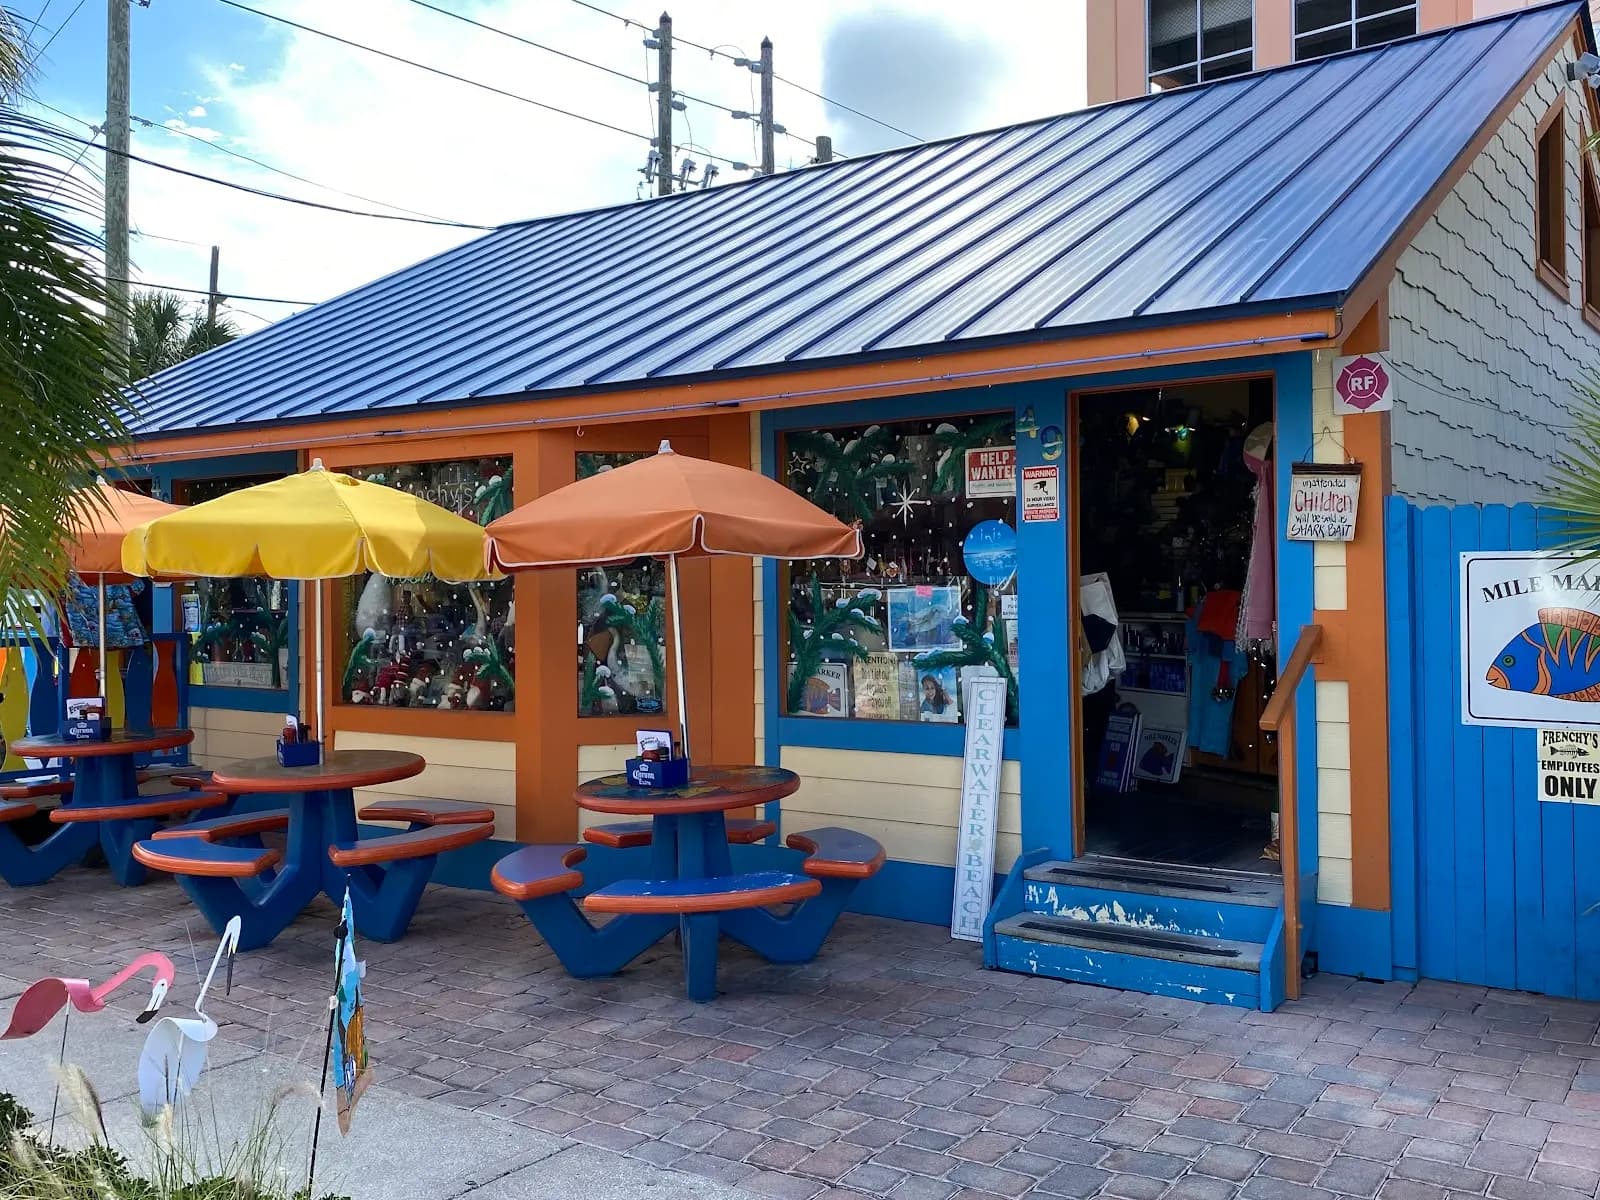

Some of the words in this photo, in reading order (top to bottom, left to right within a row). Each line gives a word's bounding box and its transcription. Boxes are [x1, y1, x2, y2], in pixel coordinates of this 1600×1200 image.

[1350, 375, 1374, 391] RF
[980, 451, 1010, 466] HELP
[1025, 469, 1056, 478] WARNING
[1302, 478, 1346, 488] unattended
[1295, 513, 1310, 523] will
[1291, 524, 1325, 538] SHARK
[1328, 524, 1353, 537] BAIT
[1480, 576, 1544, 603] MILE
[69, 727, 94, 736] Corona
[1542, 730, 1598, 749] FRENCHY'S
[968, 688, 997, 837] CLEARWATER
[1541, 760, 1600, 773] EMPLOYEES
[632, 769, 655, 780] Corona
[1545, 775, 1598, 799] ONLY
[960, 855, 984, 931] BEACH
